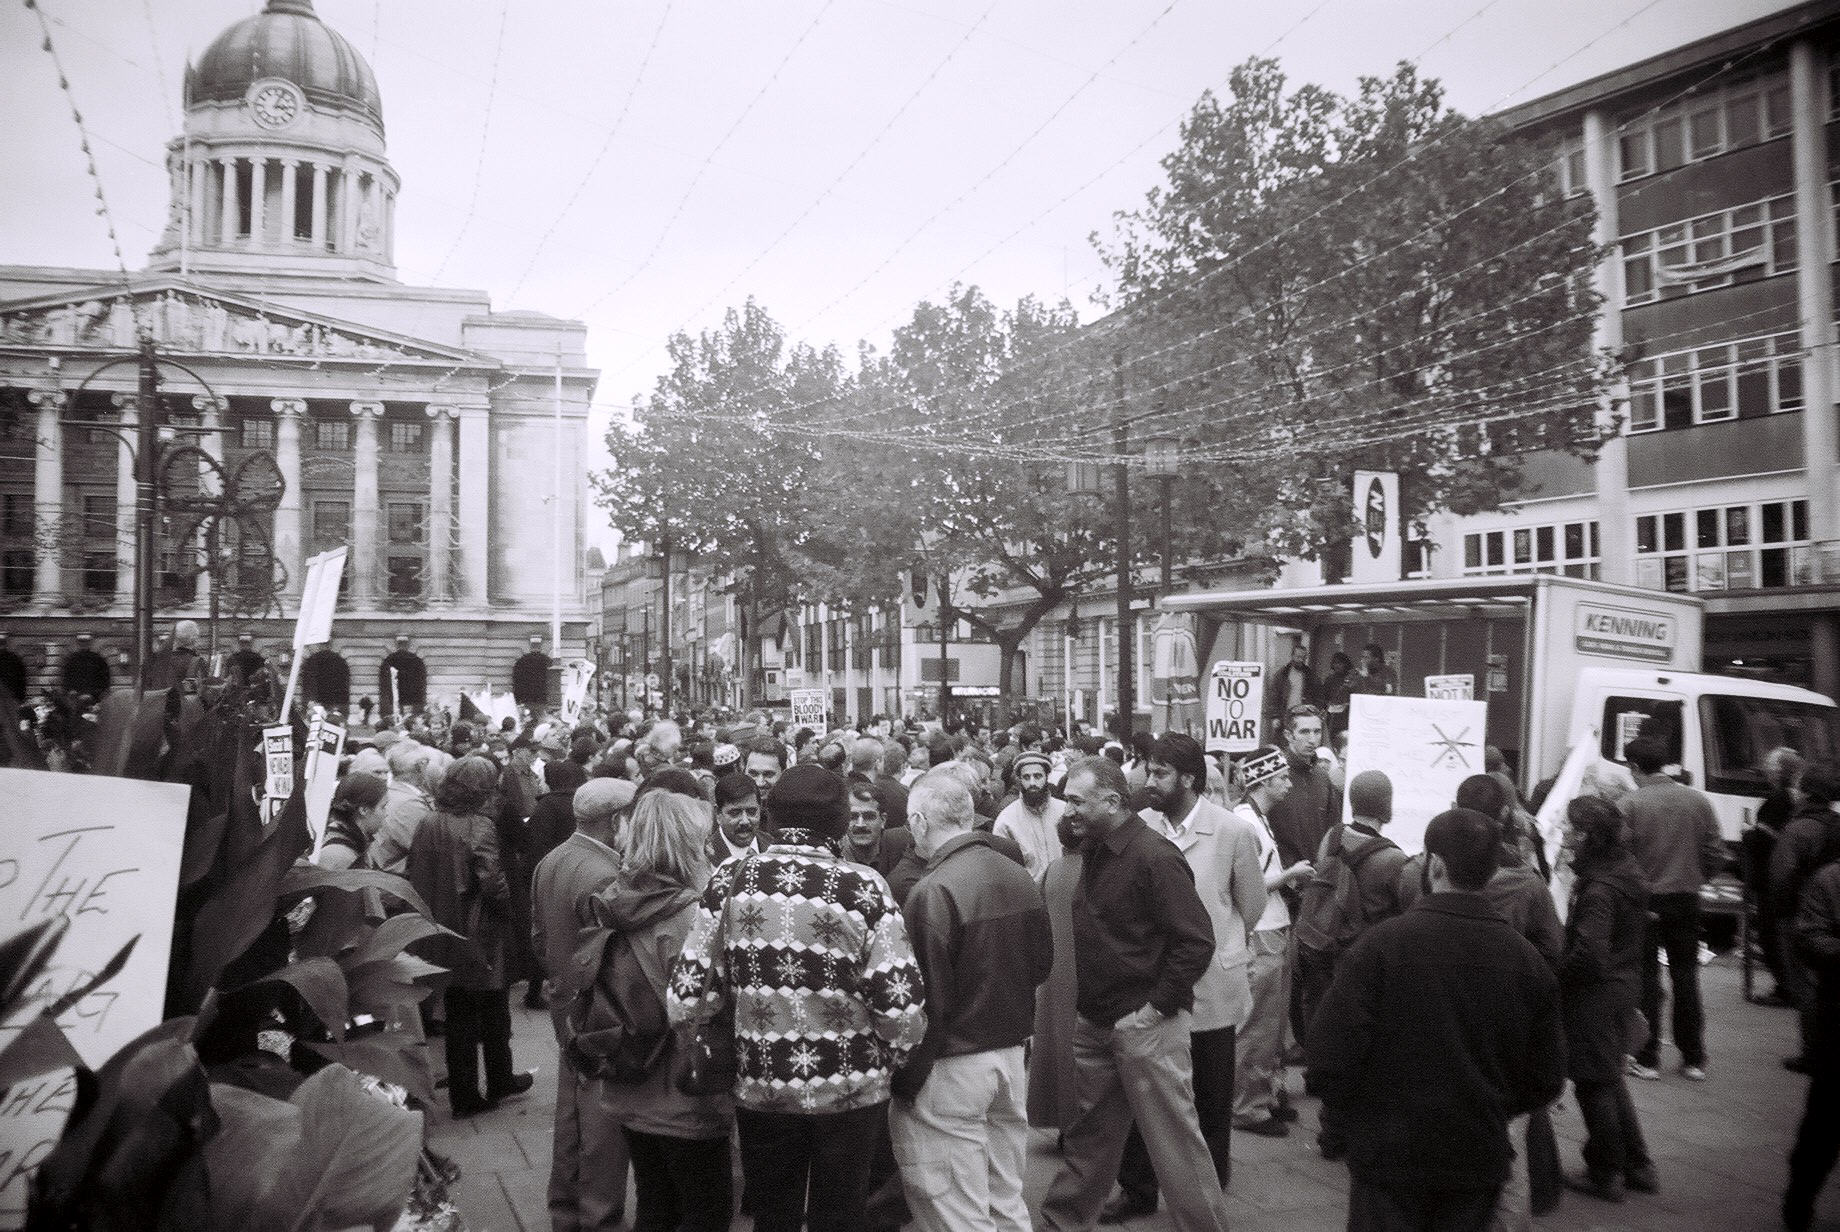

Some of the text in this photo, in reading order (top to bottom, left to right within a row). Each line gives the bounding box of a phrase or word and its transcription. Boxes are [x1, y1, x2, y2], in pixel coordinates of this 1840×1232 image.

[1584, 613, 1667, 641] KENNING
[1217, 677, 1250, 699] NO
[793, 704, 823, 714] BLOODY
[801, 714, 819, 724] WAR
[1221, 697, 1244, 719] TO
[1210, 718, 1256, 739] WAR
[20, 825, 139, 920] THE
